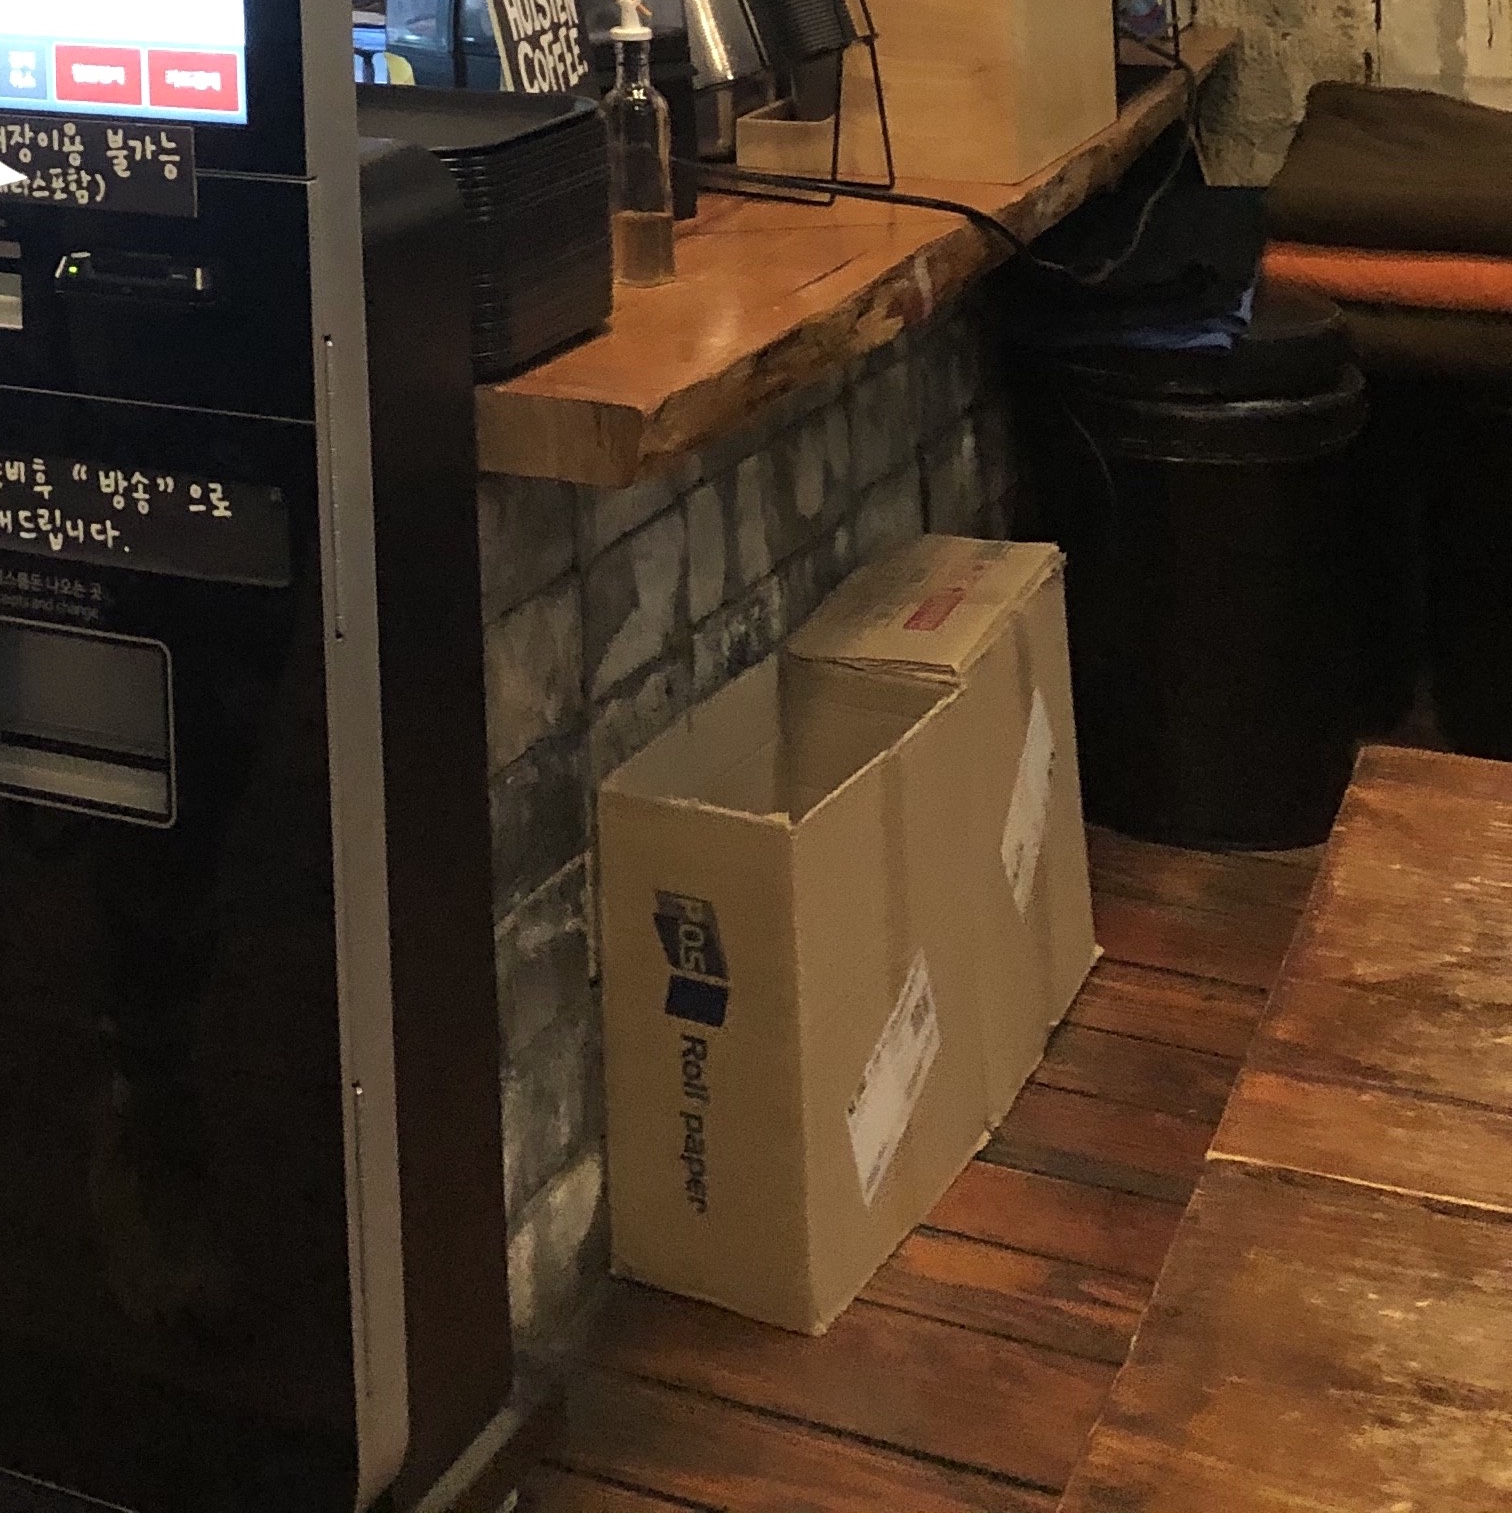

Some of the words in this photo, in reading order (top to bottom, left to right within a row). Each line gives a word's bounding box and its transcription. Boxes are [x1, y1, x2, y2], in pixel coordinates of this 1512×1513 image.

[106, 128, 181, 180] 불가능
[680, 1033, 710, 1104] Roll
[680, 1108, 710, 1214] paper
